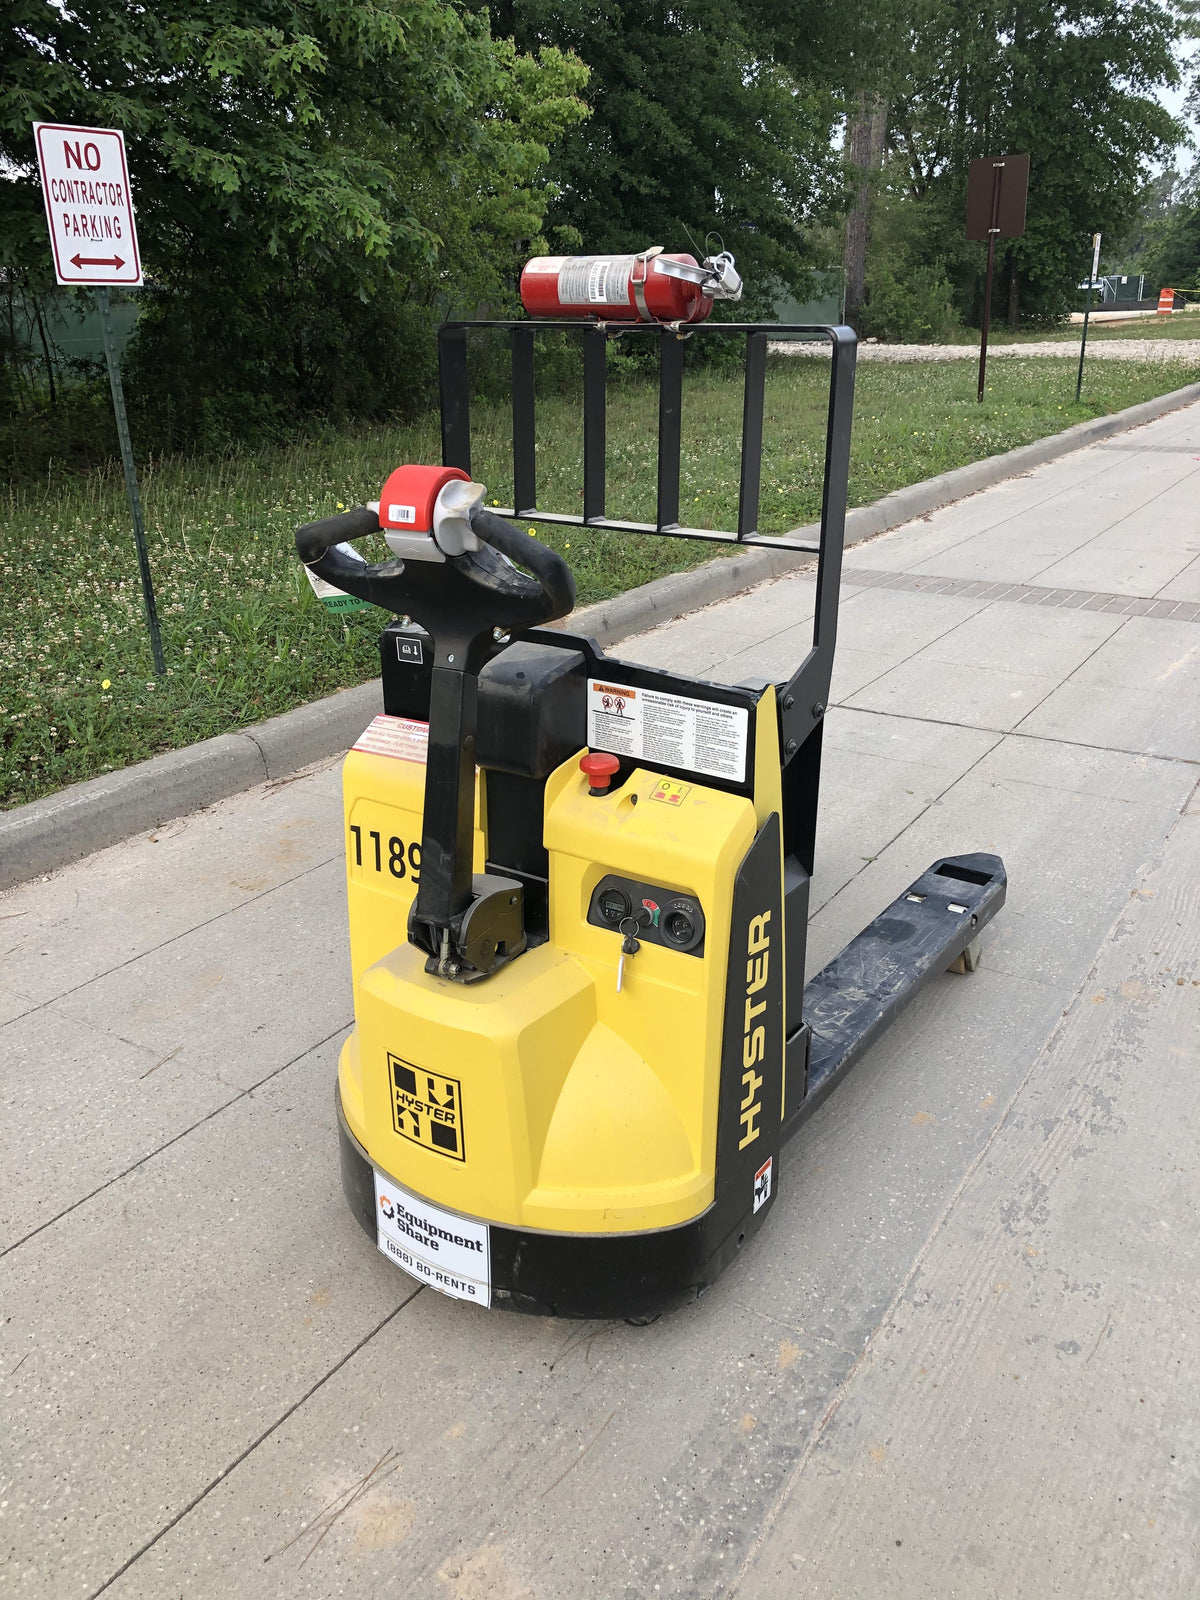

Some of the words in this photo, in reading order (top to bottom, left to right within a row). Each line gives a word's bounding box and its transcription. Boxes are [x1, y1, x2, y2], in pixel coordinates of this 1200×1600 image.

[63, 140, 101, 171] NO
[51, 178, 124, 206] CONTRACTOR
[63, 213, 122, 239] PARKING
[324, 600, 348, 608] READY
[604, 686, 630, 697] WARNING
[642, 698, 667, 706] unreasonable
[694, 703, 711, 711] warnings
[738, 909, 772, 1150] HYSTER
[396, 1090, 456, 1125] HYSTER
[396, 1203, 483, 1253] Equipment
[397, 1218, 439, 1251] Share
[386, 1240, 413, 1266] (888)
[416, 1261, 476, 1295] 80-RENTS
